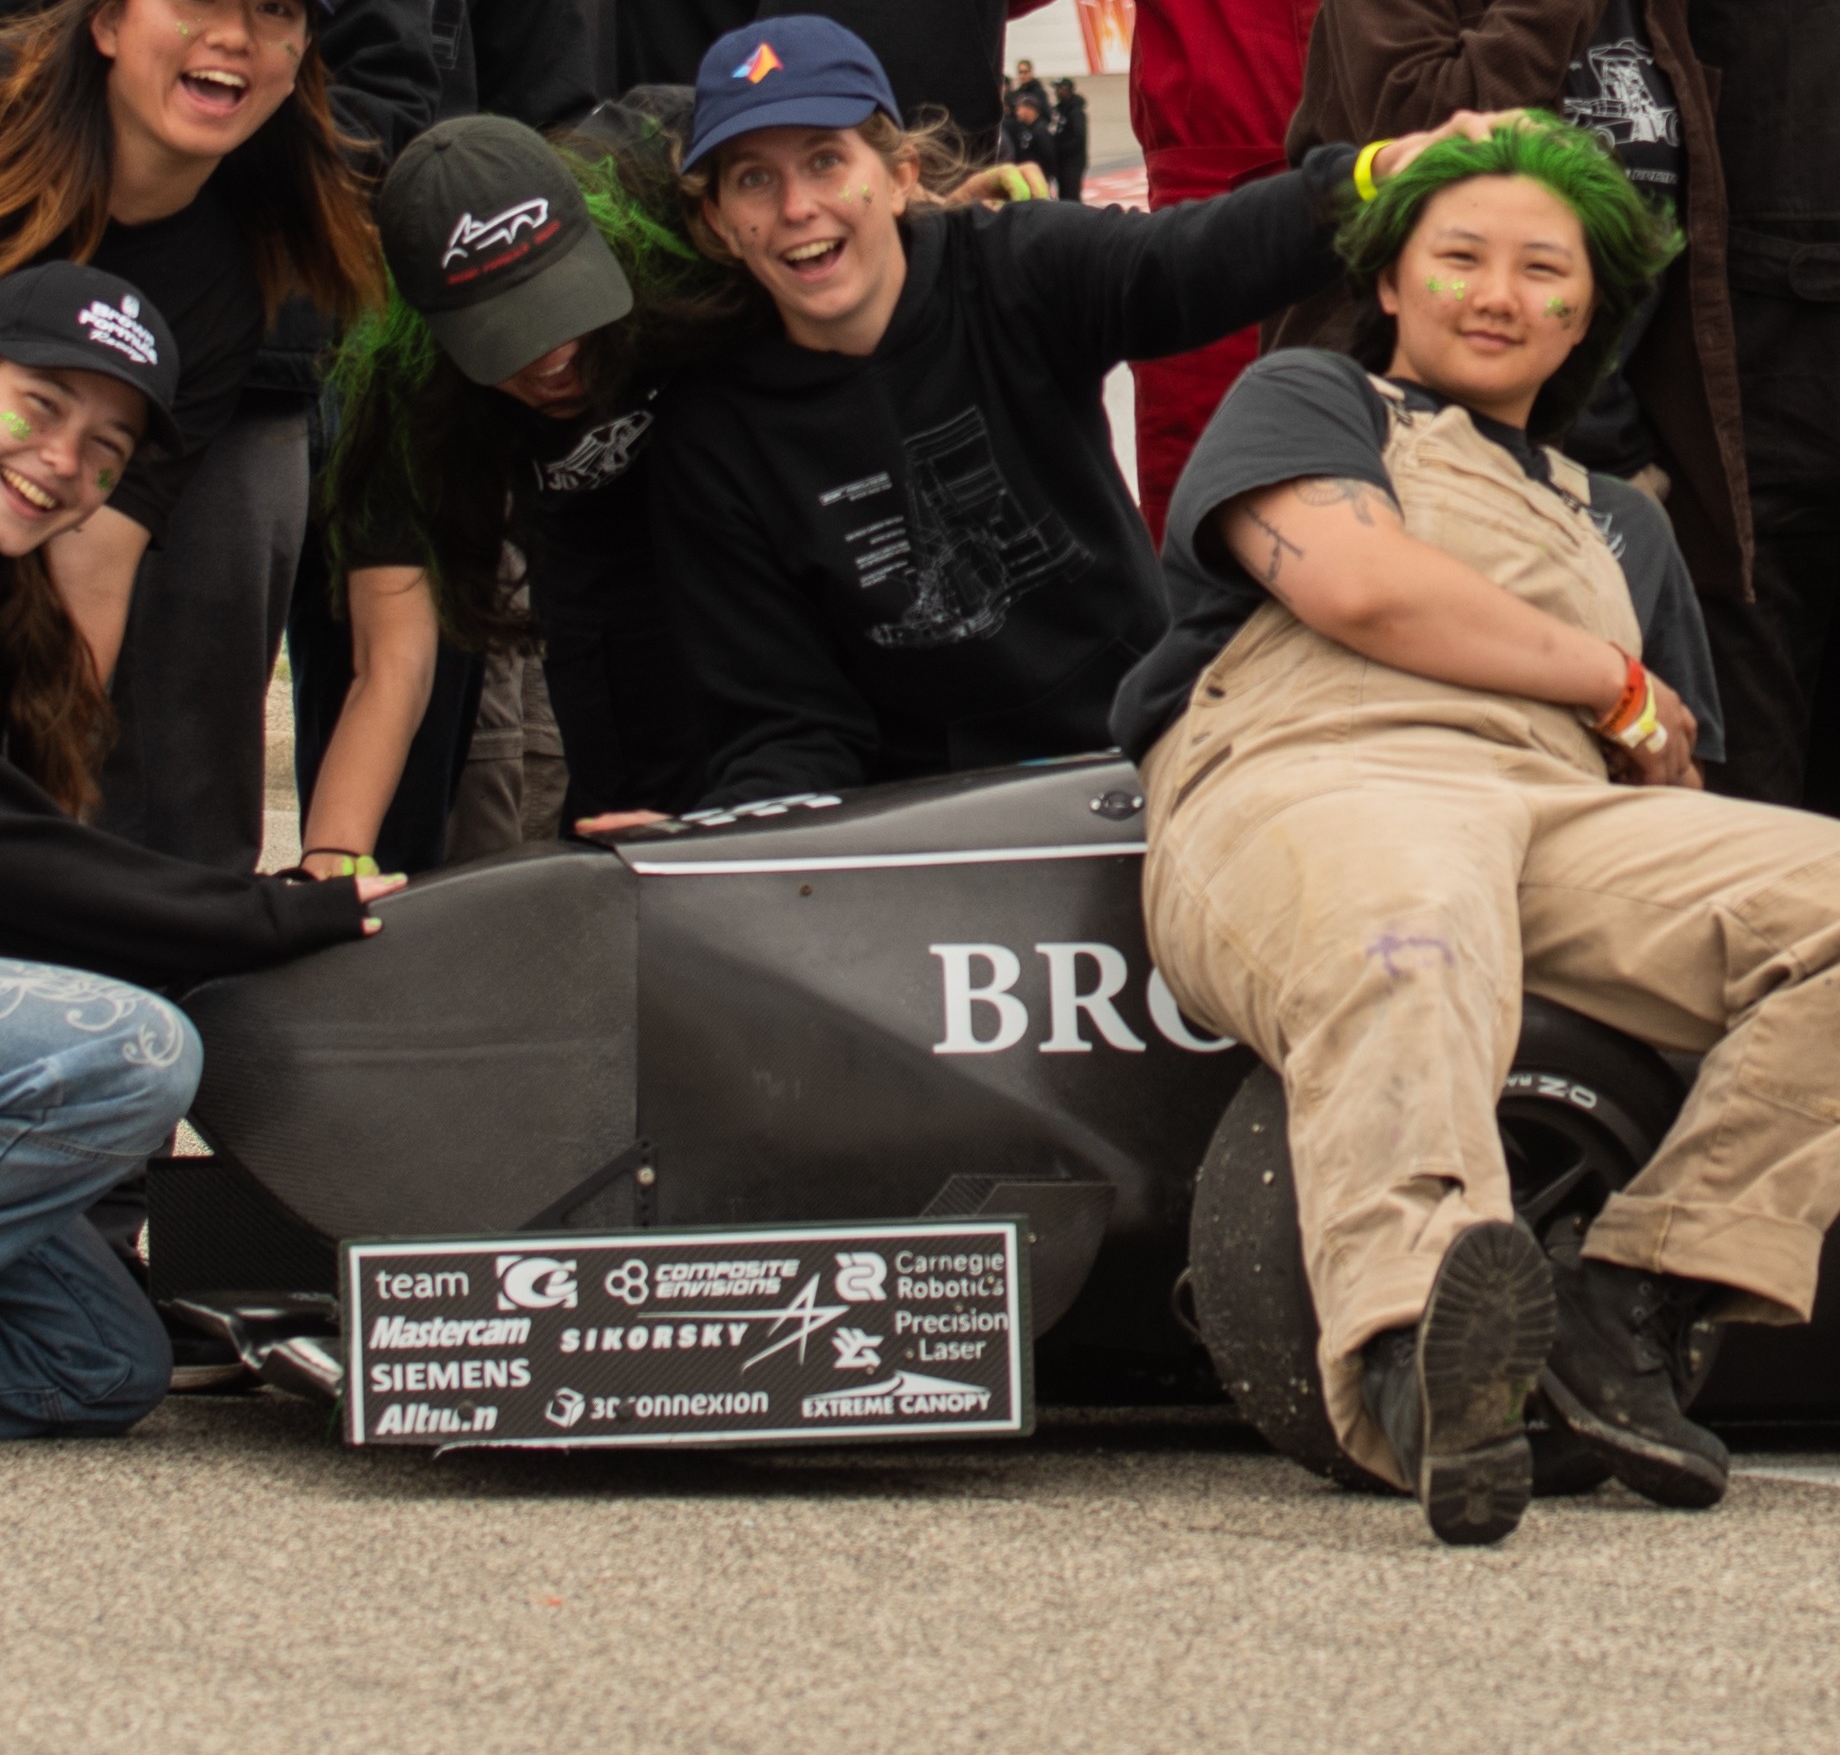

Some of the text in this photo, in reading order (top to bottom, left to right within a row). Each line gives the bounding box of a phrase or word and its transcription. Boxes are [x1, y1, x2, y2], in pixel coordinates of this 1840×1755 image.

[654, 1259, 801, 1282] COMPOSITE
[895, 1250, 1006, 1276] Carnegie
[375, 1269, 470, 1299] team
[655, 1278, 783, 1299] ENVISIONS
[370, 1315, 532, 1350] Mastercam
[895, 1307, 1010, 1336] Precision
[560, 1322, 749, 1353] SIKORSKY
[918, 1338, 988, 1363] Laser
[370, 1358, 532, 1393] SIEMENS
[801, 1391, 993, 1419] EXTREME CANOPY
